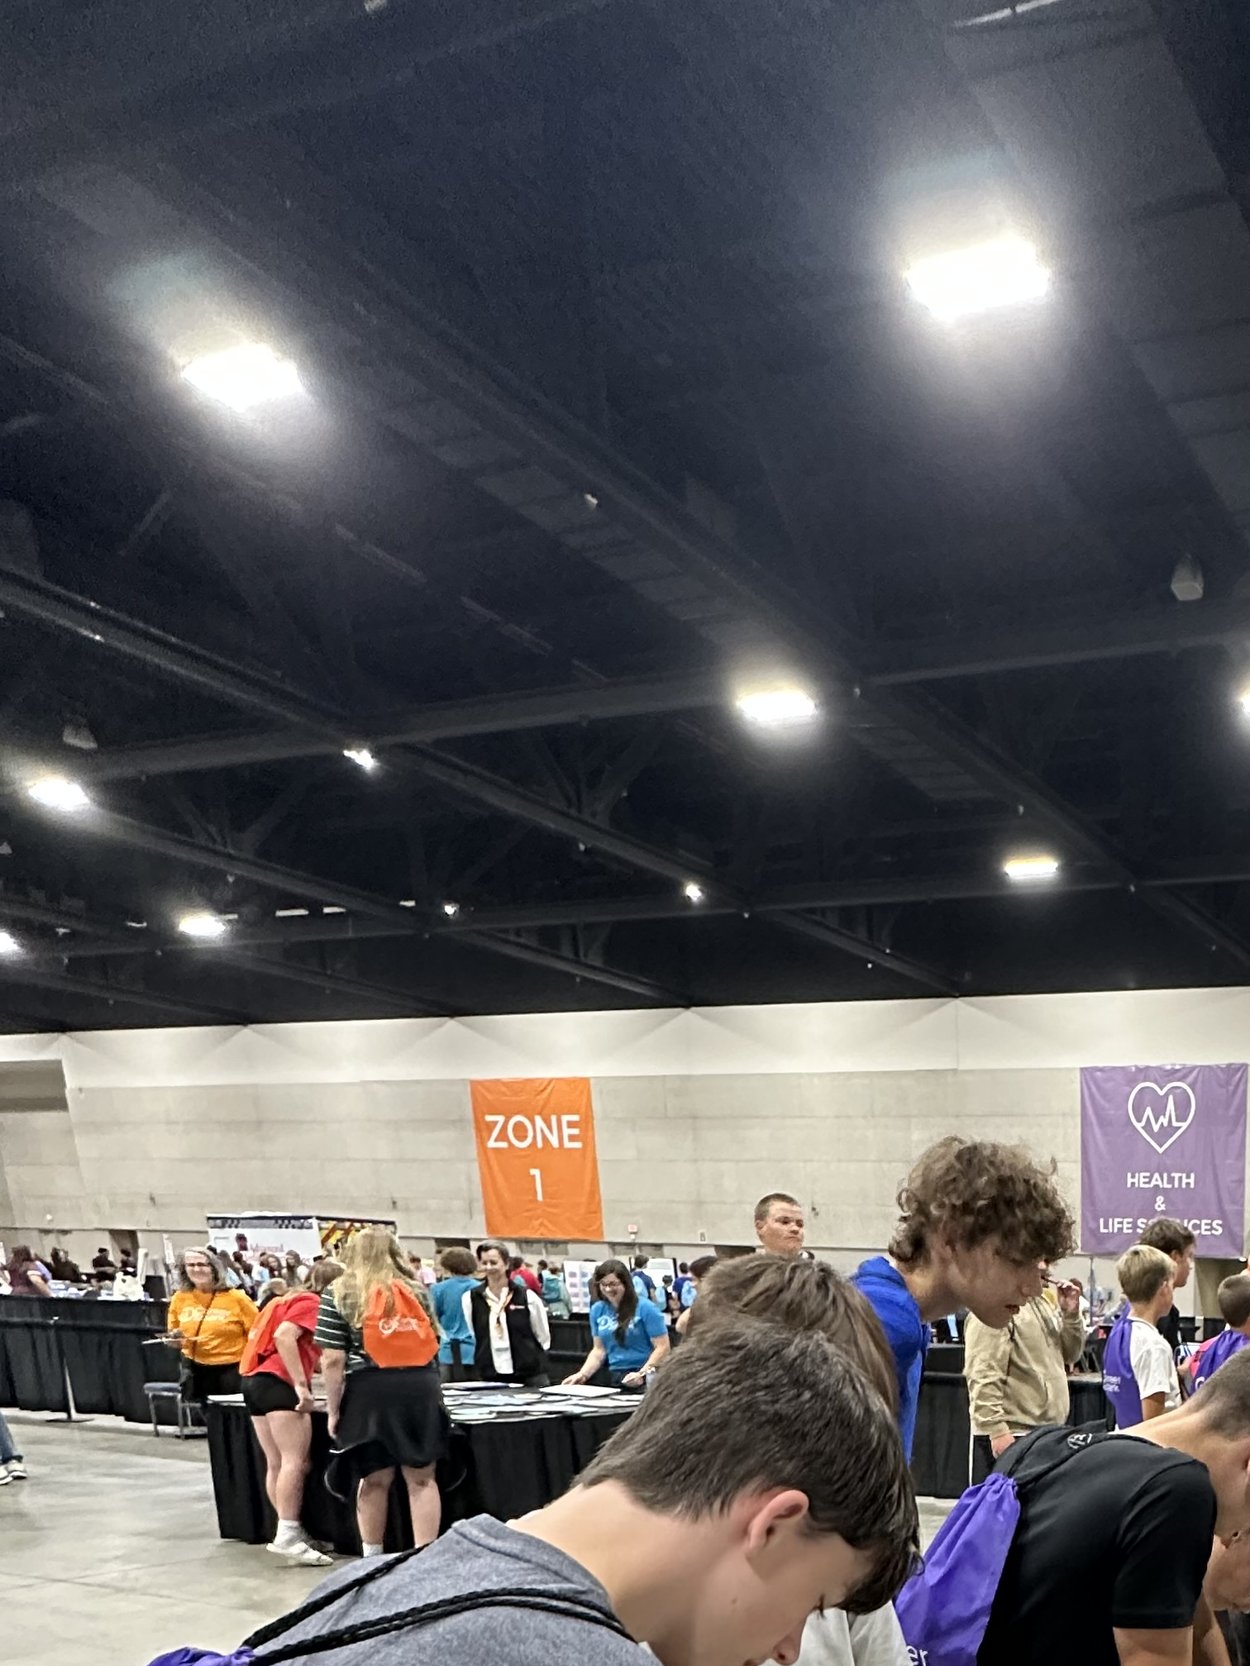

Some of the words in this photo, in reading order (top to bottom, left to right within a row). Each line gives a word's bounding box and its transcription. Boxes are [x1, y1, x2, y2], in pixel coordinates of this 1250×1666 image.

[485, 1115, 583, 1148] ZONE
[529, 1168, 543, 1201] 1
[1127, 1172, 1195, 1188] HEALTH
[1155, 1196, 1166, 1211] &
[1100, 1218, 1133, 1233] LIFE
[1136, 1218, 1223, 1235] SCES
